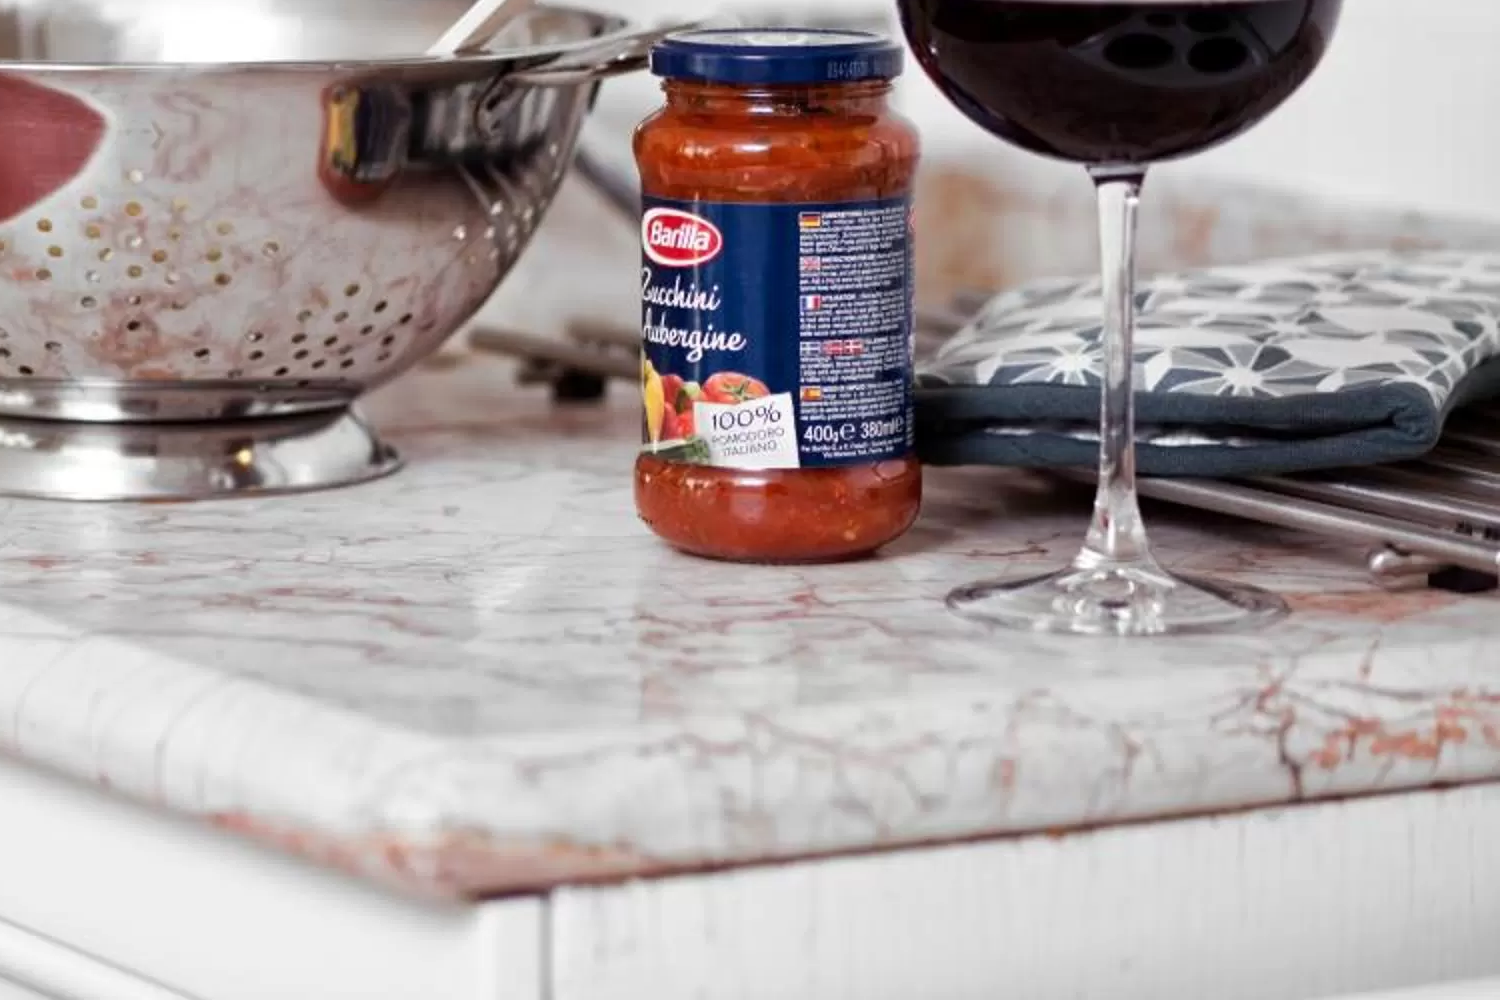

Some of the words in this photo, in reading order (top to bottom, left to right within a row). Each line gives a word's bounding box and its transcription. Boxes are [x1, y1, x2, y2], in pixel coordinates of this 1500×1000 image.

[651, 220, 711, 250] Barilla
[642, 266, 721, 311] Zucchini
[712, 401, 782, 430] 100%
[711, 426, 785, 445] POMODORO
[723, 440, 777, 457] ITALIANO
